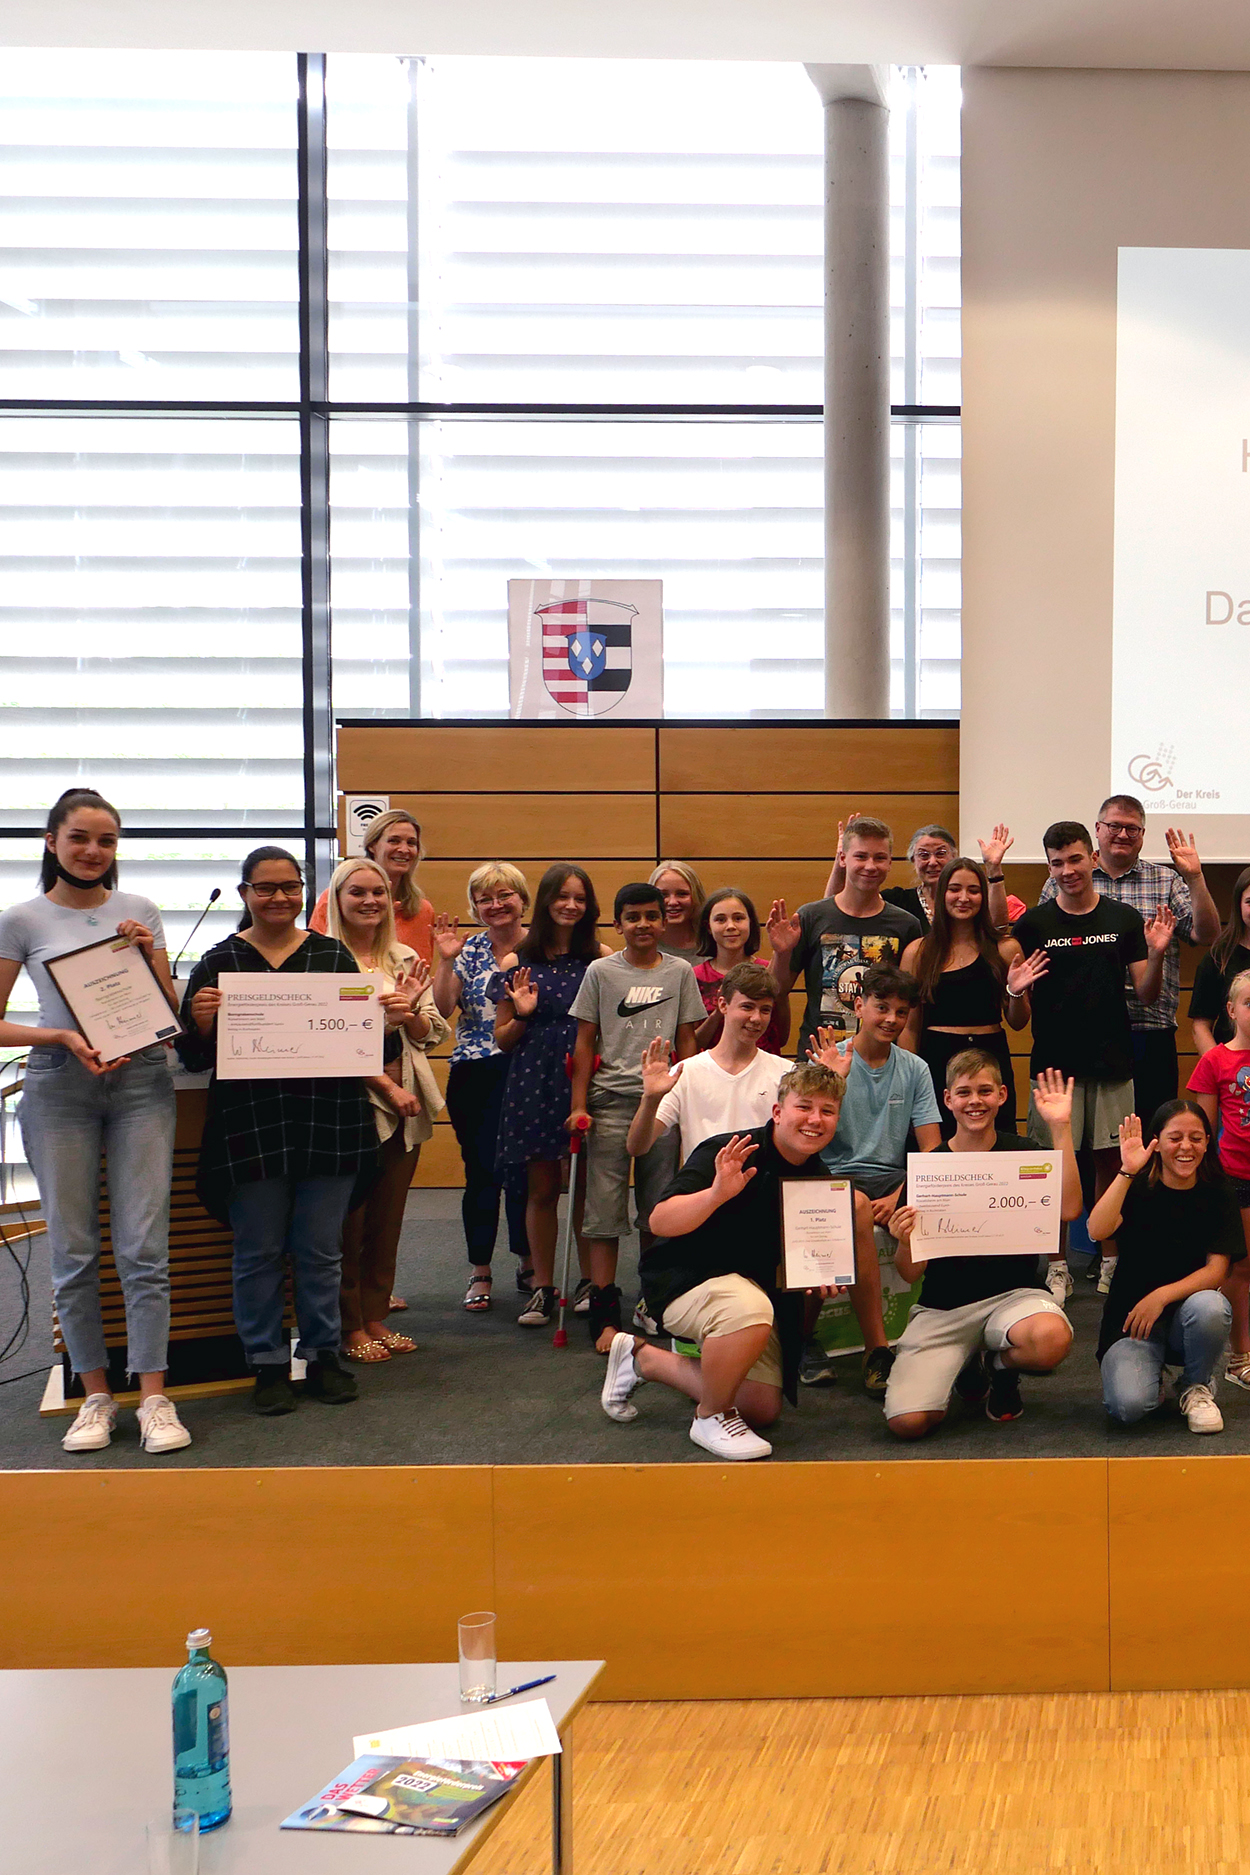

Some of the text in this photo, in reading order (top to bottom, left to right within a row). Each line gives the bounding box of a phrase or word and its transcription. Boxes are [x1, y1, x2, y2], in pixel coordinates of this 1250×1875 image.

[1176, 789, 1220, 799] Der Kreis
[1143, 800, 1197, 809] Groß-Gerau
[1044, 937, 1072, 948] JACK
[1082, 933, 1117, 945] JONES
[838, 982, 858, 994] STAY
[624, 986, 664, 1004] NIKE
[362, 1018, 373, 1030] €
[625, 1019, 662, 1029] AIR
[915, 1173, 994, 1182] PREISGELDSCHECK
[1041, 1195, 1052, 1206] €
[335, 1767, 383, 1801] WETTER
[395, 1775, 432, 1791] 2022
[412, 1770, 485, 1791] Energieförderpreis
[320, 1782, 349, 1801] DAS
